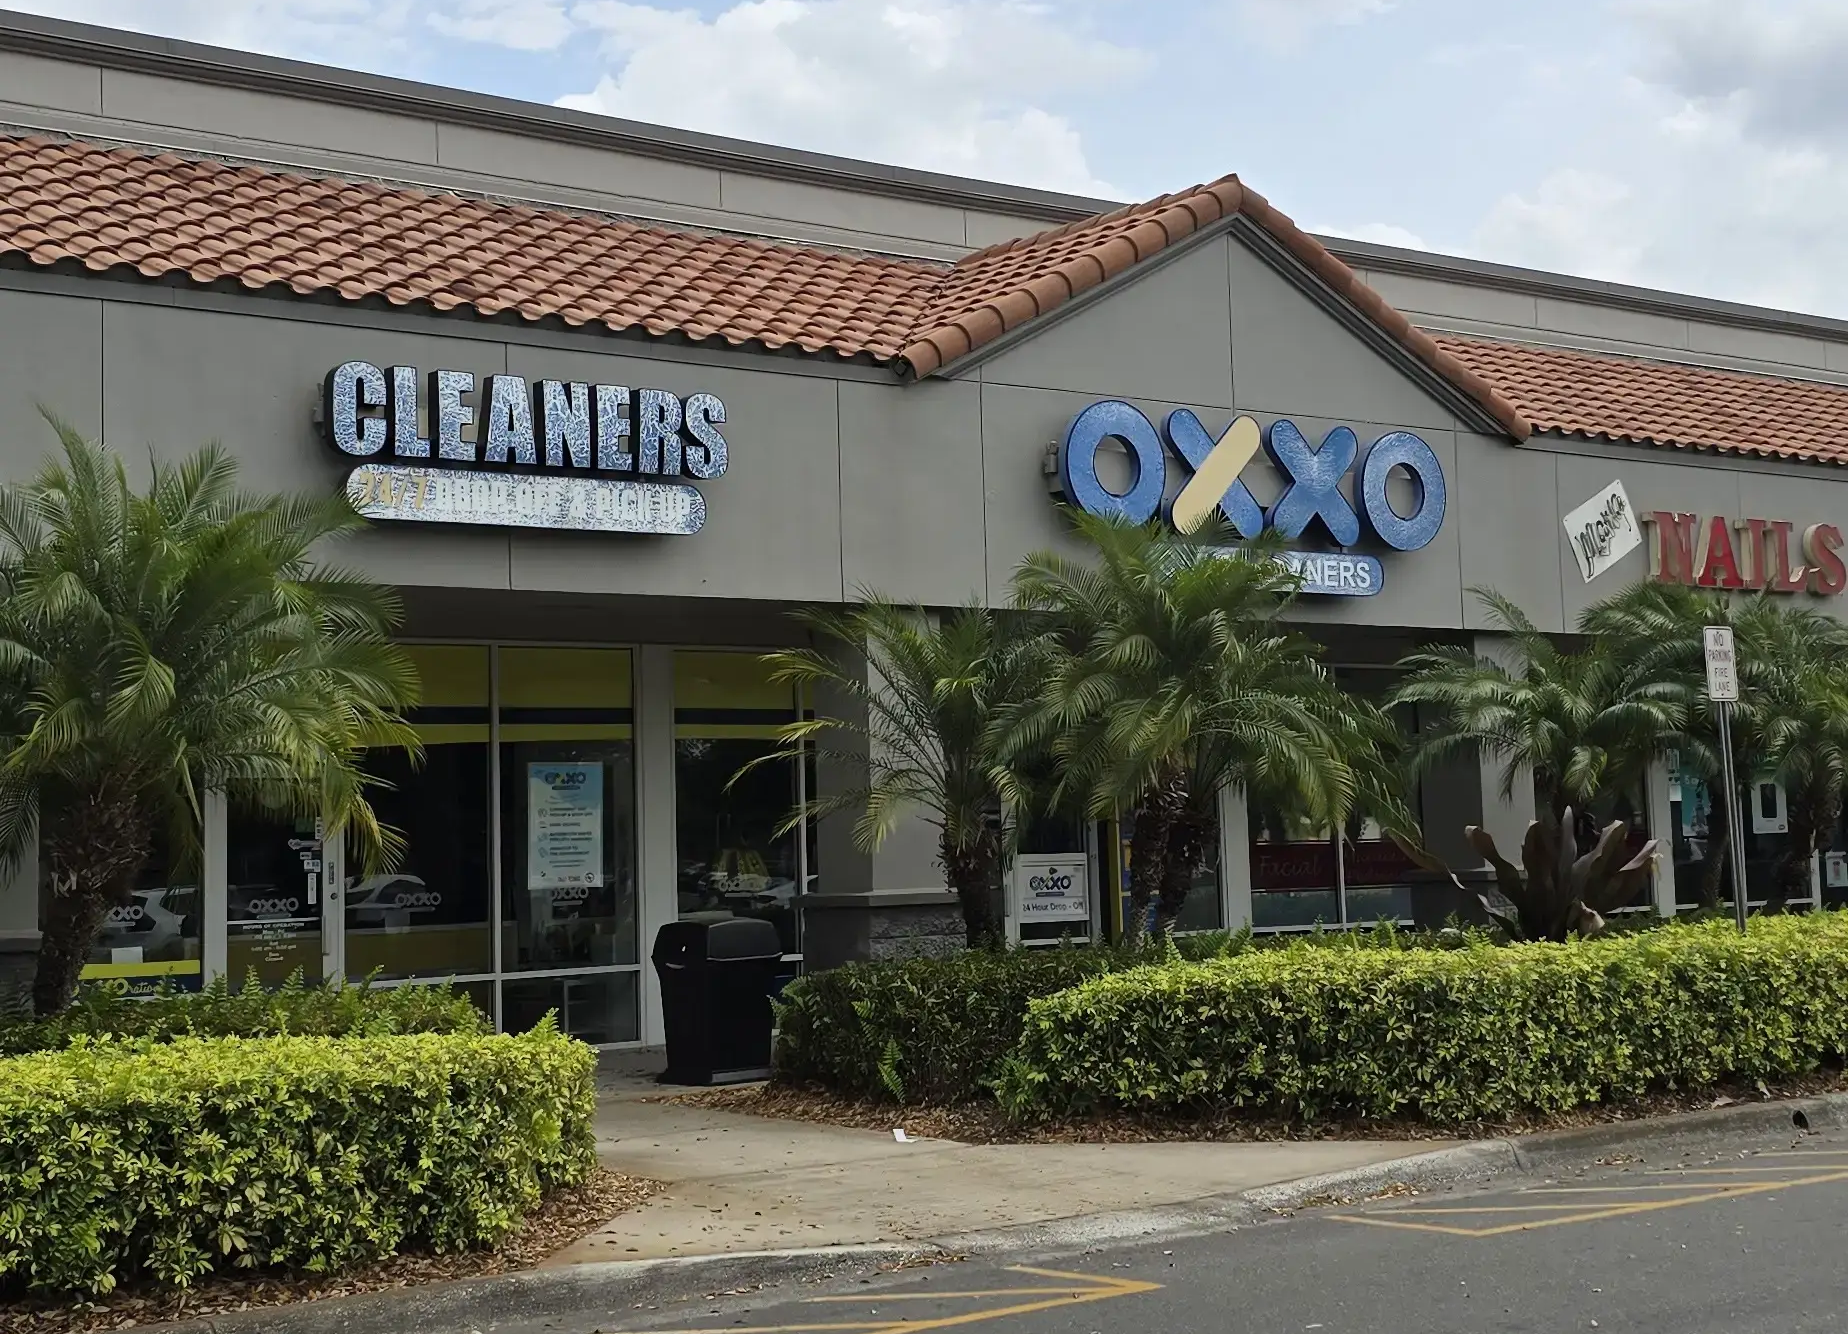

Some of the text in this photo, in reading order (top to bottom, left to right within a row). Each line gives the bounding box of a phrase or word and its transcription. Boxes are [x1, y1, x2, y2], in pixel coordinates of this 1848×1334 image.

[329, 360, 730, 480] CLEANERS
[1060, 399, 1447, 552] OXXO
[359, 471, 428, 511] 24/7
[435, 477, 505, 515] DROP
[660, 490, 693, 524] UP
[1642, 511, 1847, 595] NAILS
[1712, 633, 1724, 647] NO
[1708, 649, 1732, 663] PARKING
[1714, 667, 1728, 678] FIRE
[1715, 681, 1731, 692] LANE
[1029, 875, 1072, 892] OXXO
[248, 897, 299, 914] OXXO
[394, 891, 442, 907] OXXO
[1022, 903, 1031, 912] 24
[1031, 903, 1049, 912] Hour
[1050, 902, 1067, 912] Drop
